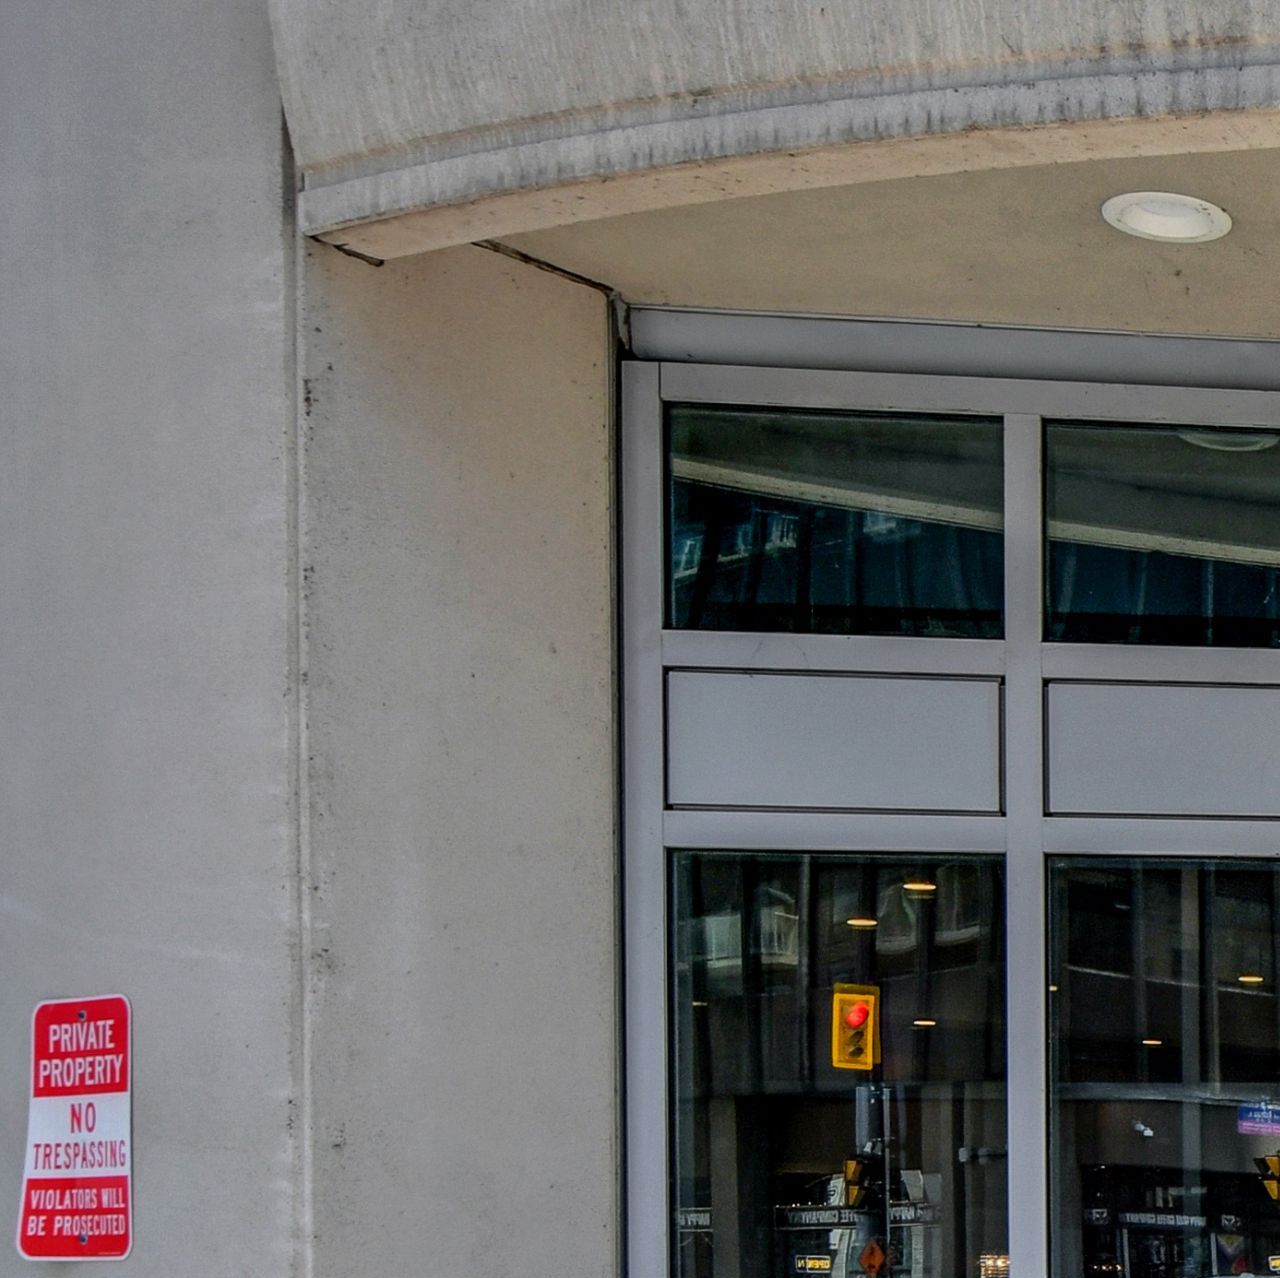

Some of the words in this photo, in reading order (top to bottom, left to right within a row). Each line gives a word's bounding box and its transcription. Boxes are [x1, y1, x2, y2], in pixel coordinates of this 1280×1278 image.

[49, 1020, 114, 1053] PRIVATE
[38, 1054, 123, 1088] PROPERTY
[70, 1102, 96, 1133] NO
[33, 1140, 126, 1170] TRESPASSING
[30, 1188, 98, 1210] VIOLATORS
[102, 1186, 125, 1209] WILL
[27, 1215, 46, 1236] BE
[53, 1214, 125, 1236] PROSECUTED
